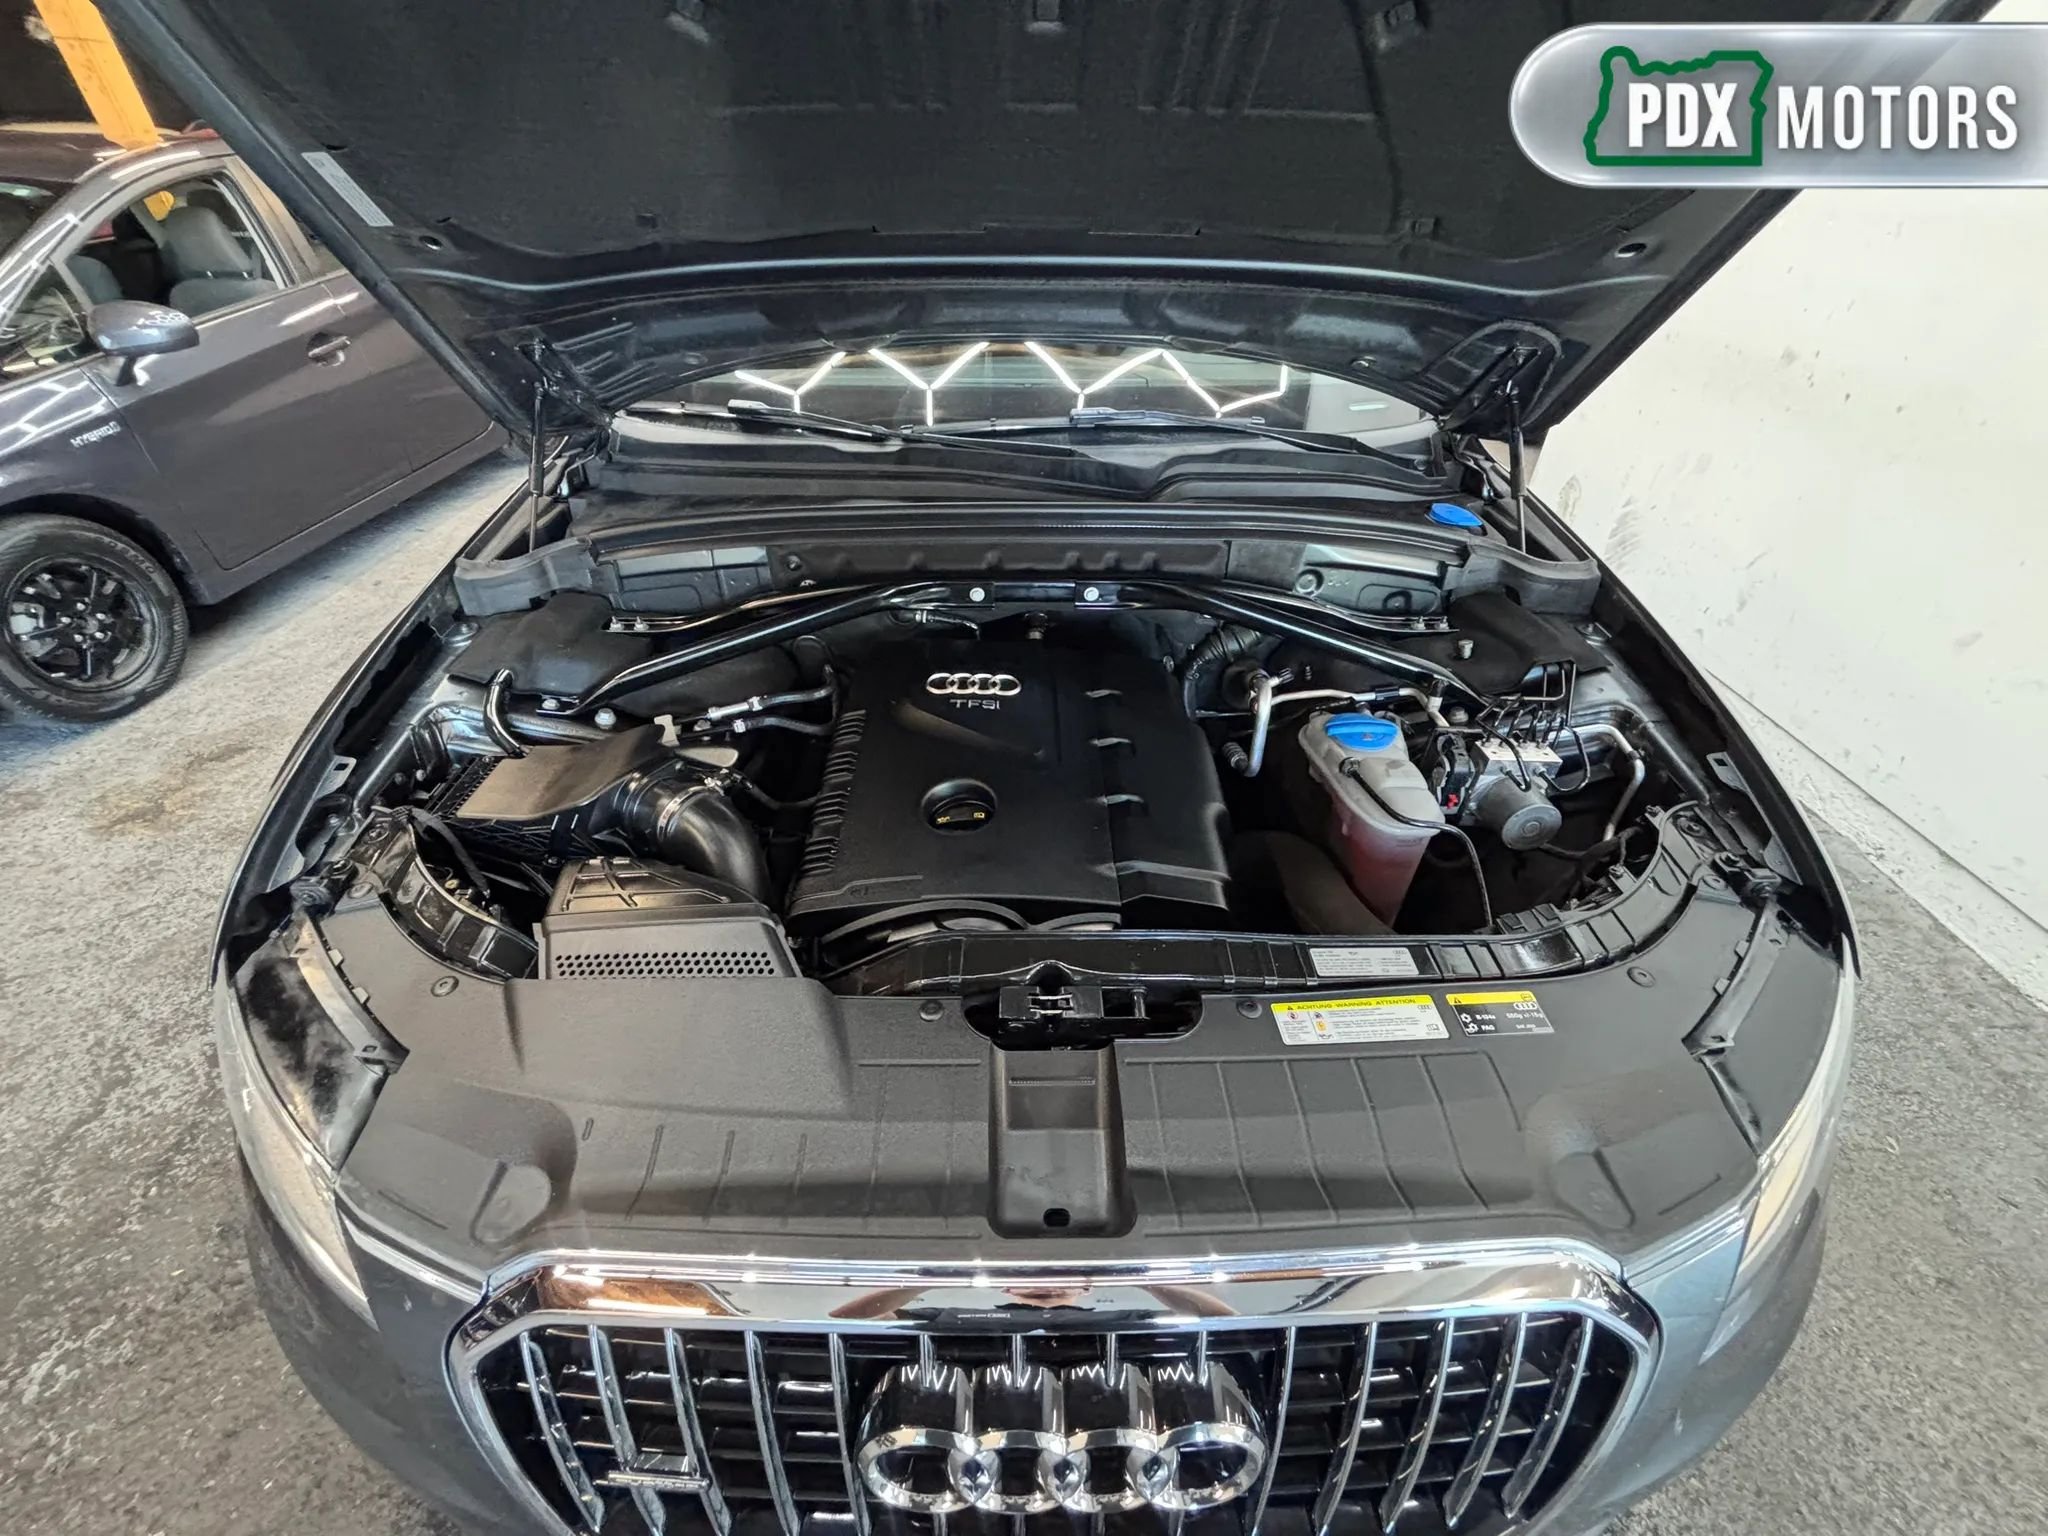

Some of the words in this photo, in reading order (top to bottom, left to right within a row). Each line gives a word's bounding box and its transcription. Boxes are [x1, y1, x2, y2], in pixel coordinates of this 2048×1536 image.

[70, 424, 115, 448] HYBRID
[950, 699, 1000, 710] TFSI
[1296, 1002, 1333, 1010] ACHTUNG
[1335, 1000, 1372, 1008] WARNING
[1376, 998, 1416, 1006] ATTENTION
